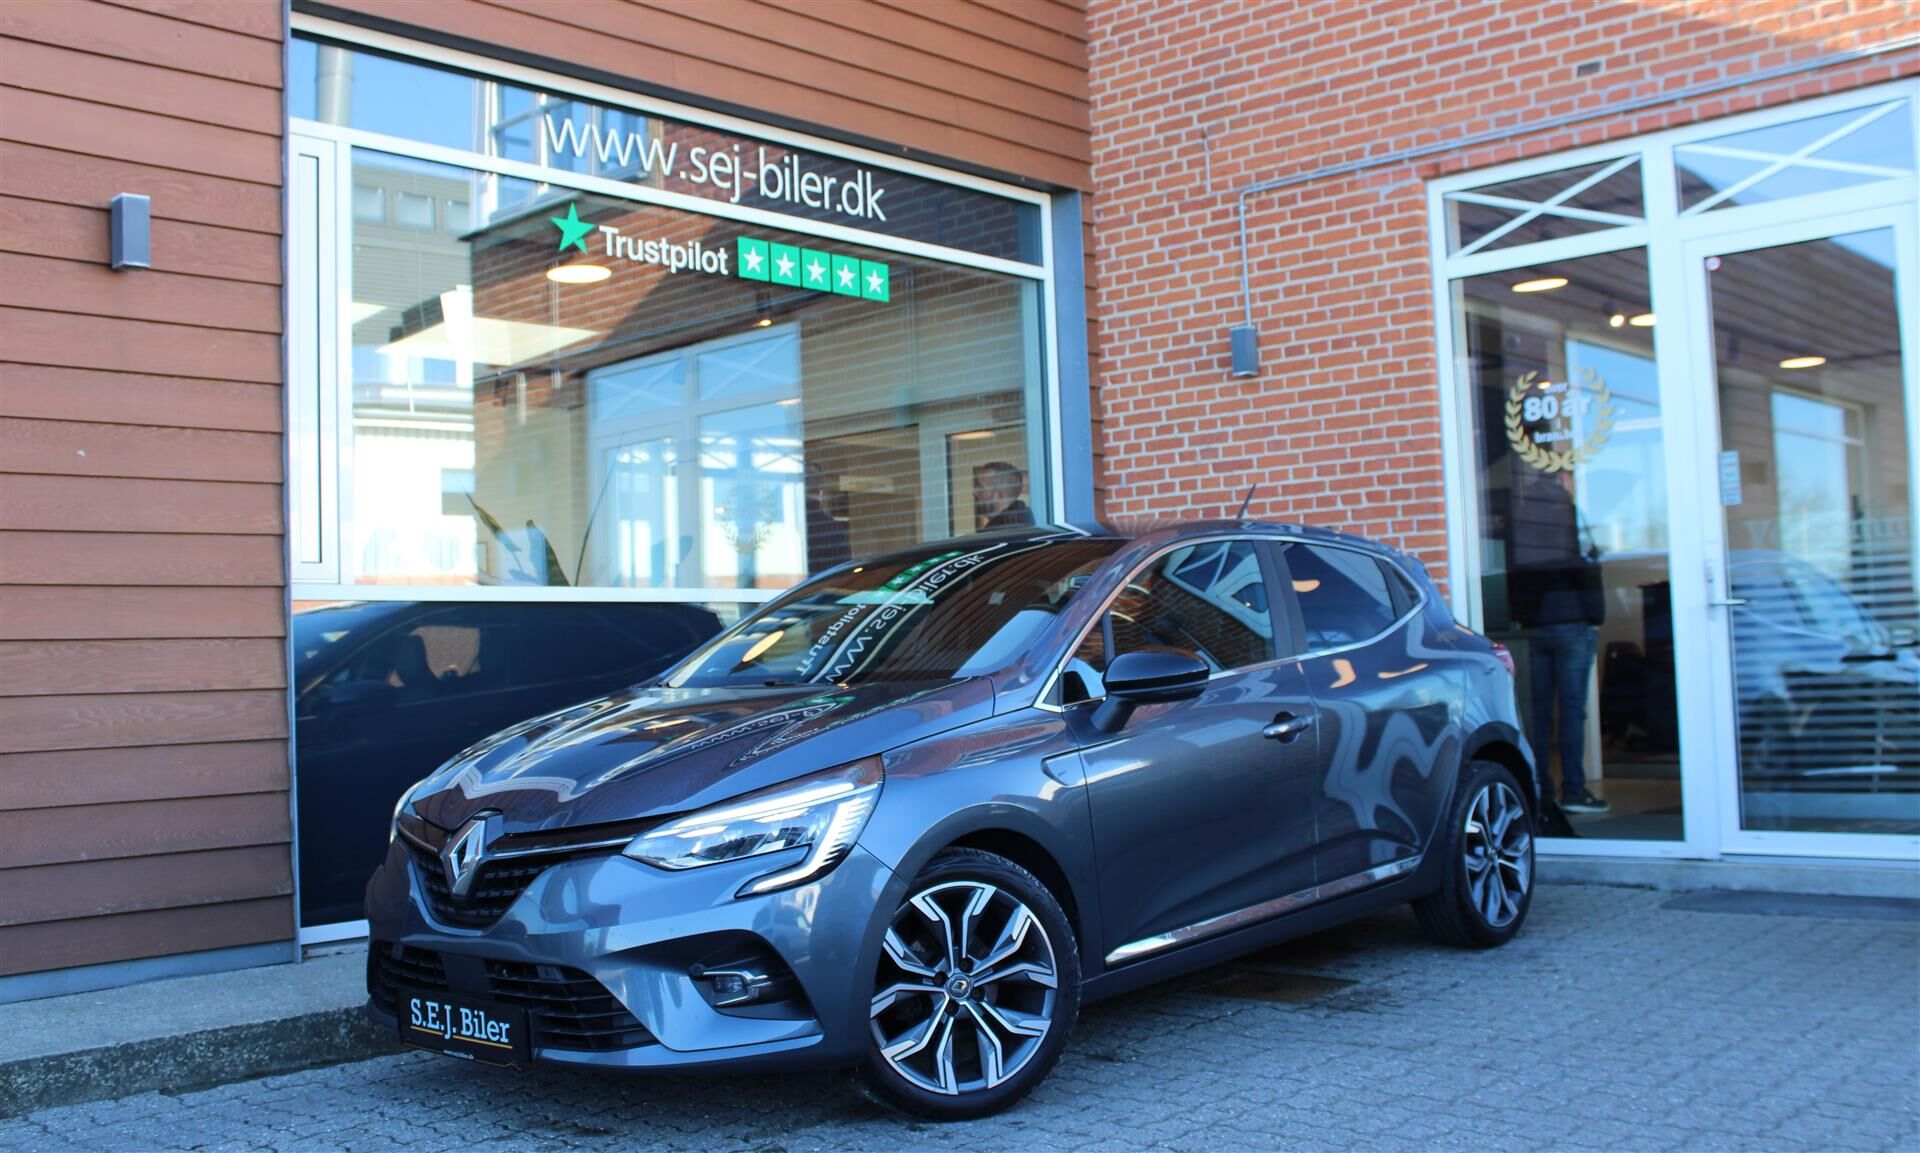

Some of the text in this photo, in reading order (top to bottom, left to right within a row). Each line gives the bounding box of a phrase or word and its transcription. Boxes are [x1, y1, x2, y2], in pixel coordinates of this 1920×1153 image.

[544, 114, 887, 222] www.sej-biler.dk
[599, 225, 729, 276] Trustpilot
[1523, 395, 1559, 422] 80
[410, 998, 510, 1043] S.E.J. Biler
